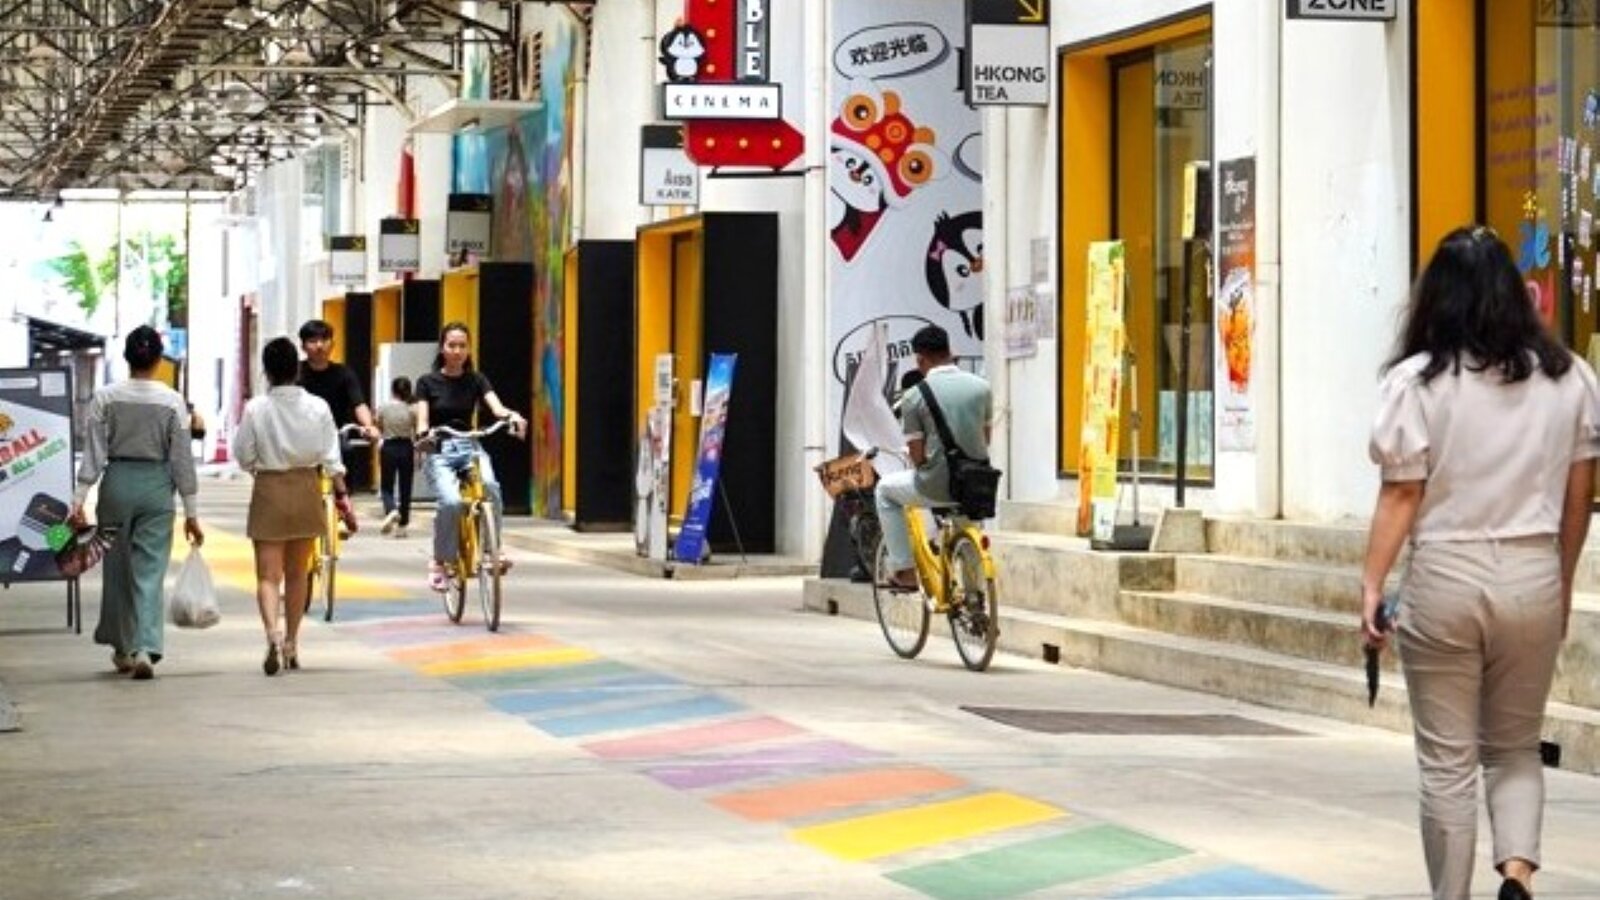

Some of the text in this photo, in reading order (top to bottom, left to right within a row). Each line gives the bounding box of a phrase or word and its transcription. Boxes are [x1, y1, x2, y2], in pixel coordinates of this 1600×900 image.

[849, 34, 928, 65] 欢迎光临
[974, 65, 1046, 83] HKONG
[673, 95, 770, 108] CINEMA
[975, 85, 1008, 100] TEA
[0, 428, 48, 467] BALL
